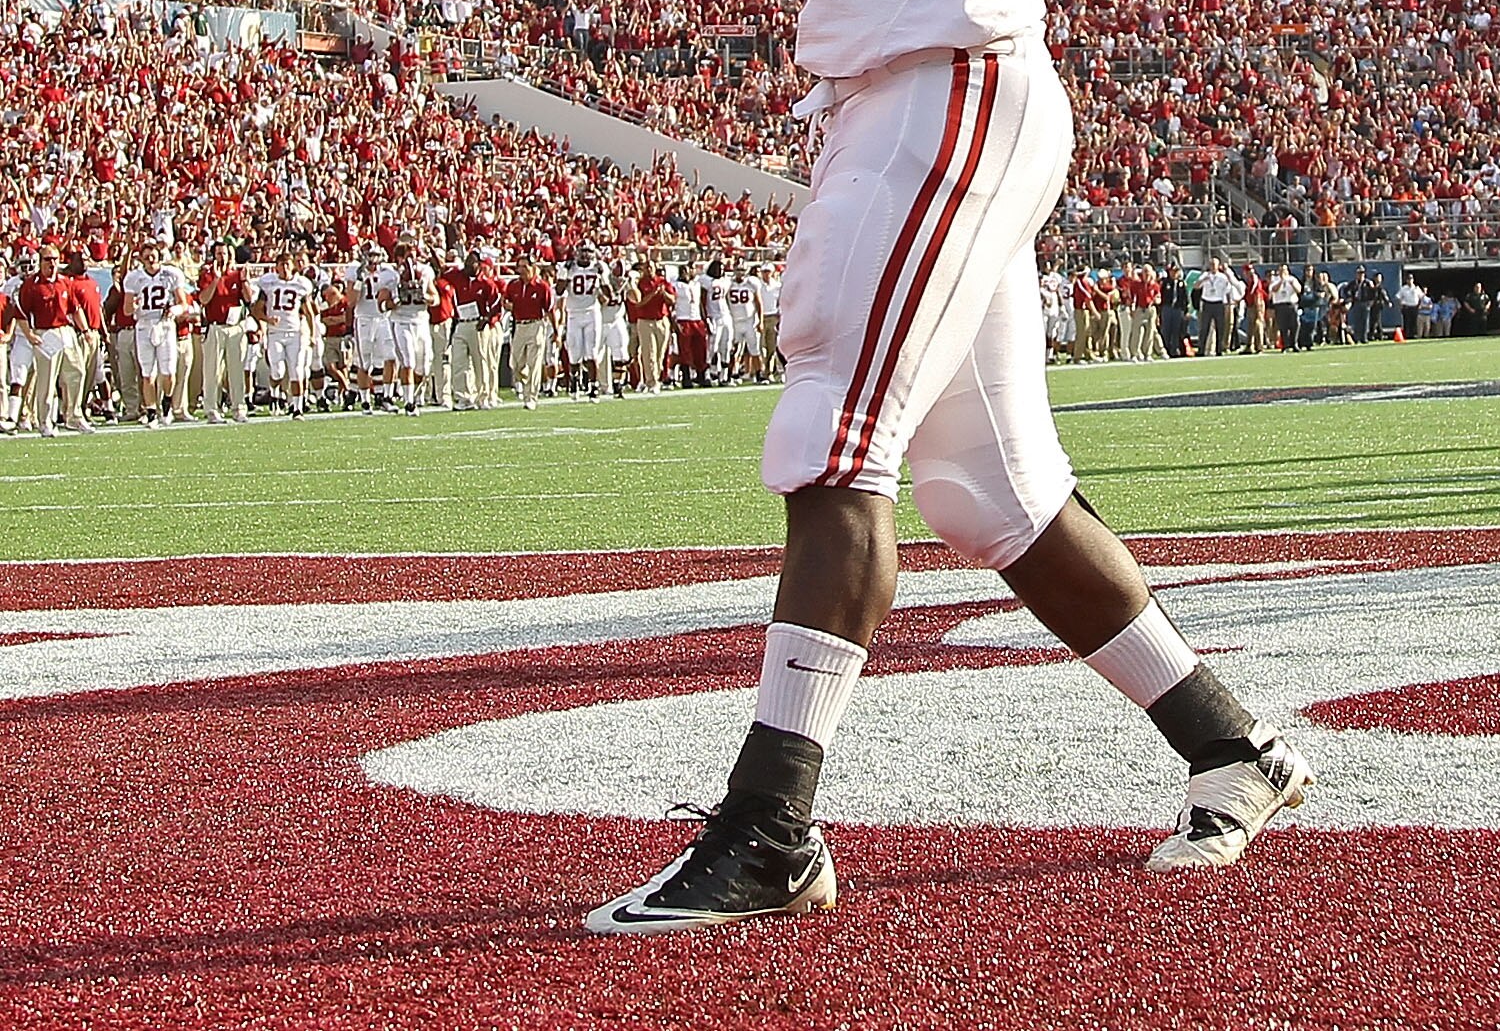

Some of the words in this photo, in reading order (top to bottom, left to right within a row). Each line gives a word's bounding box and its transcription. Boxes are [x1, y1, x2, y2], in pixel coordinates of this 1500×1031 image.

[572, 274, 597, 296] 87
[142, 285, 166, 311] 12
[272, 288, 297, 311] 13
[729, 289, 750, 304] 58
